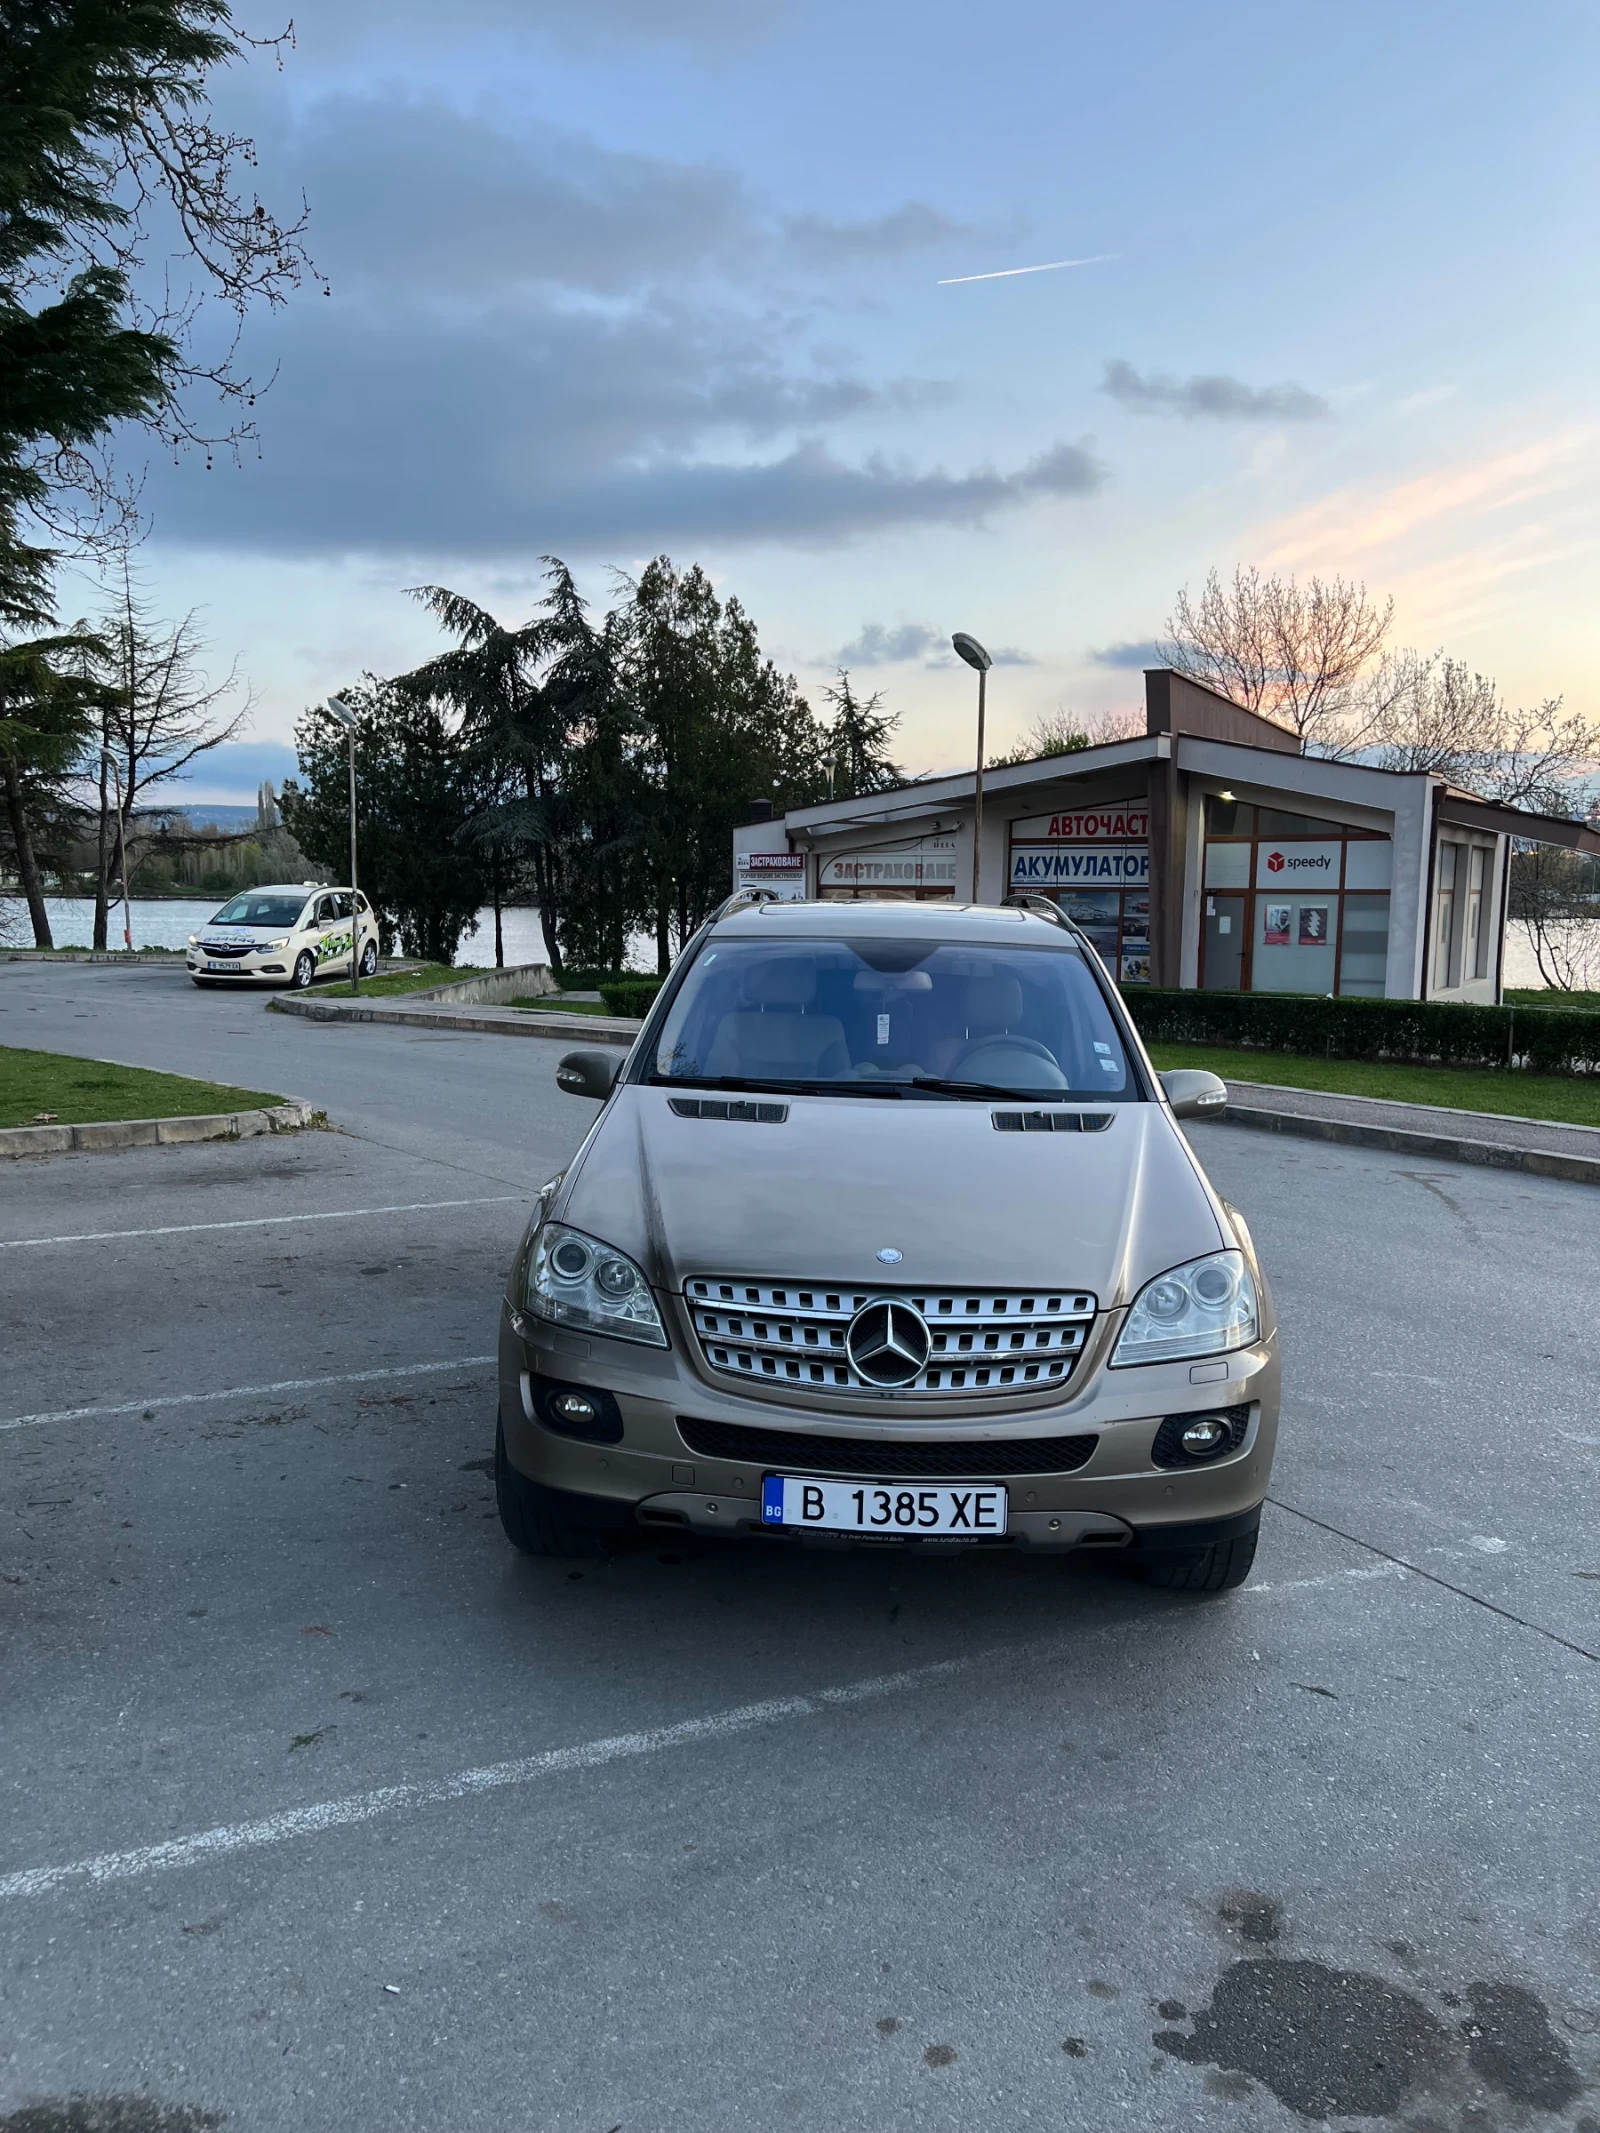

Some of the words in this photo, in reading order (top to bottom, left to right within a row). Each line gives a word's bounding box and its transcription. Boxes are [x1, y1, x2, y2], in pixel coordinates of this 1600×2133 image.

[750, 856, 802, 867] ЗАСТРАХОВАНЕ
[1287, 854, 1331, 870] speedy
[834, 863, 956, 880] ЗАСТРАХОВАНЕ
[766, 1505, 782, 1517] BG
[802, 1485, 825, 1521] B
[852, 1489, 939, 1528] 1385
[948, 1492, 997, 1528] XE
